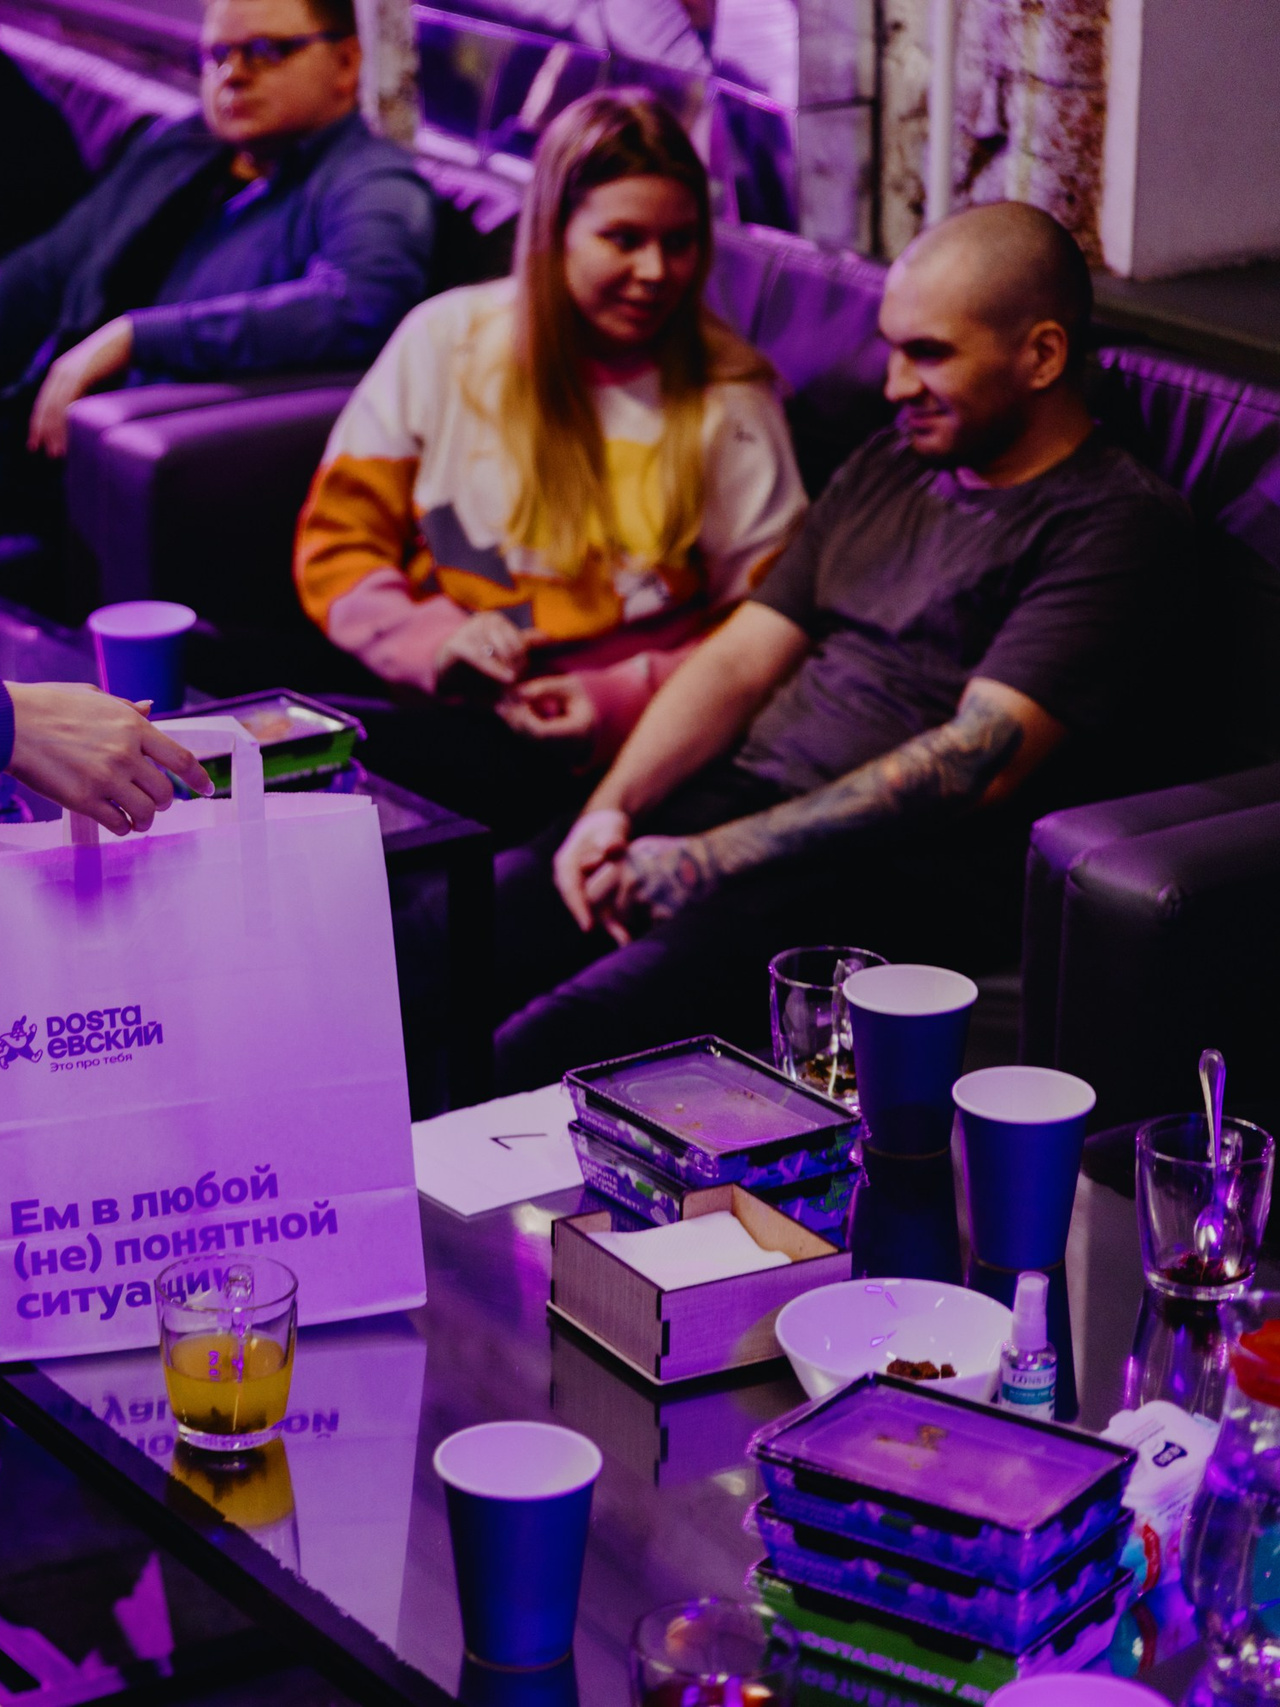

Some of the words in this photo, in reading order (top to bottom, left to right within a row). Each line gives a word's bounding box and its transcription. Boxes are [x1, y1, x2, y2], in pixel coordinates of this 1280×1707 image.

[50, 1062, 74, 1073] Это
[76, 1058, 100, 1070] про
[103, 1052, 133, 1065] тебя
[10, 1199, 81, 1236] Ем
[92, 1198, 121, 1226] в
[131, 1163, 279, 1223] любой
[13, 1232, 103, 1281] (не)
[115, 1199, 339, 1267] понятной
